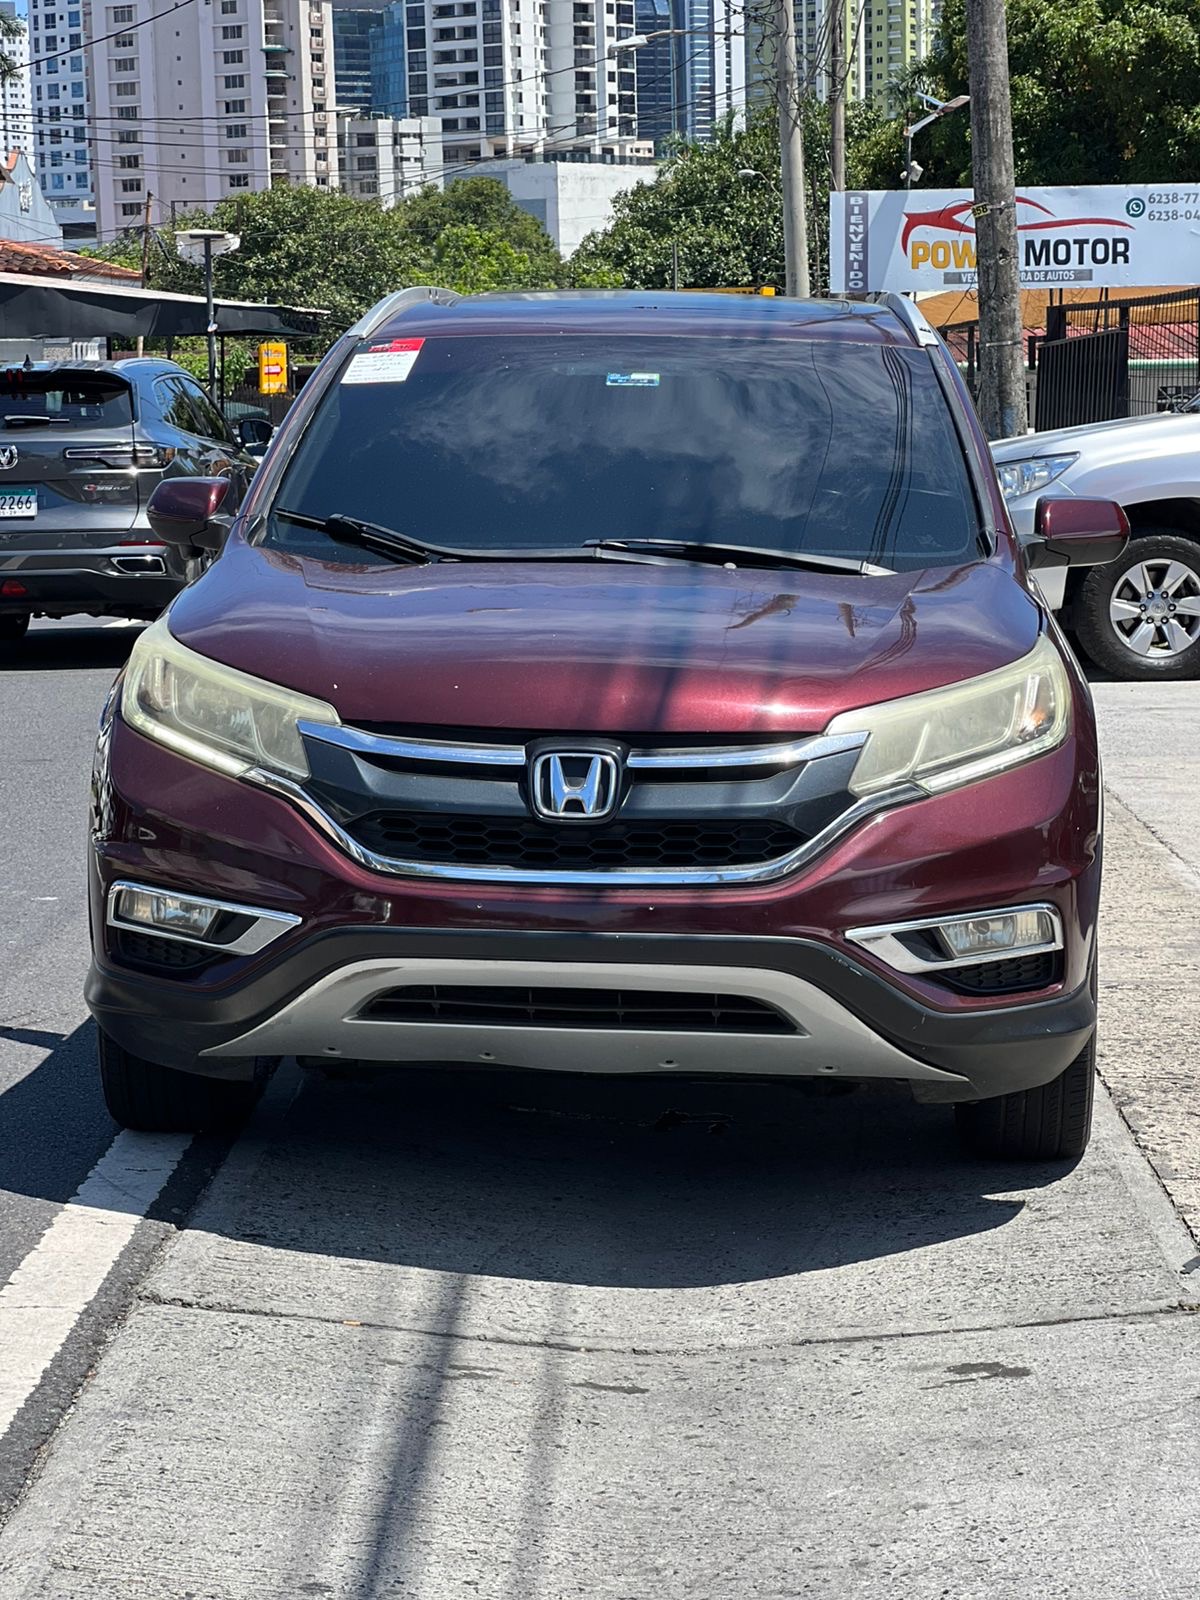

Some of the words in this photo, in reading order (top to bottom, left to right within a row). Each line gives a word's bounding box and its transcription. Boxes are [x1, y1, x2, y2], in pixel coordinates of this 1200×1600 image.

[849, 196, 864, 289] BIENVENIDO
[911, 240, 977, 270] POW
[1025, 238, 1130, 267] MOTOR
[1034, 271, 1045, 281] DE
[1047, 270, 1075, 281] AUTOS
